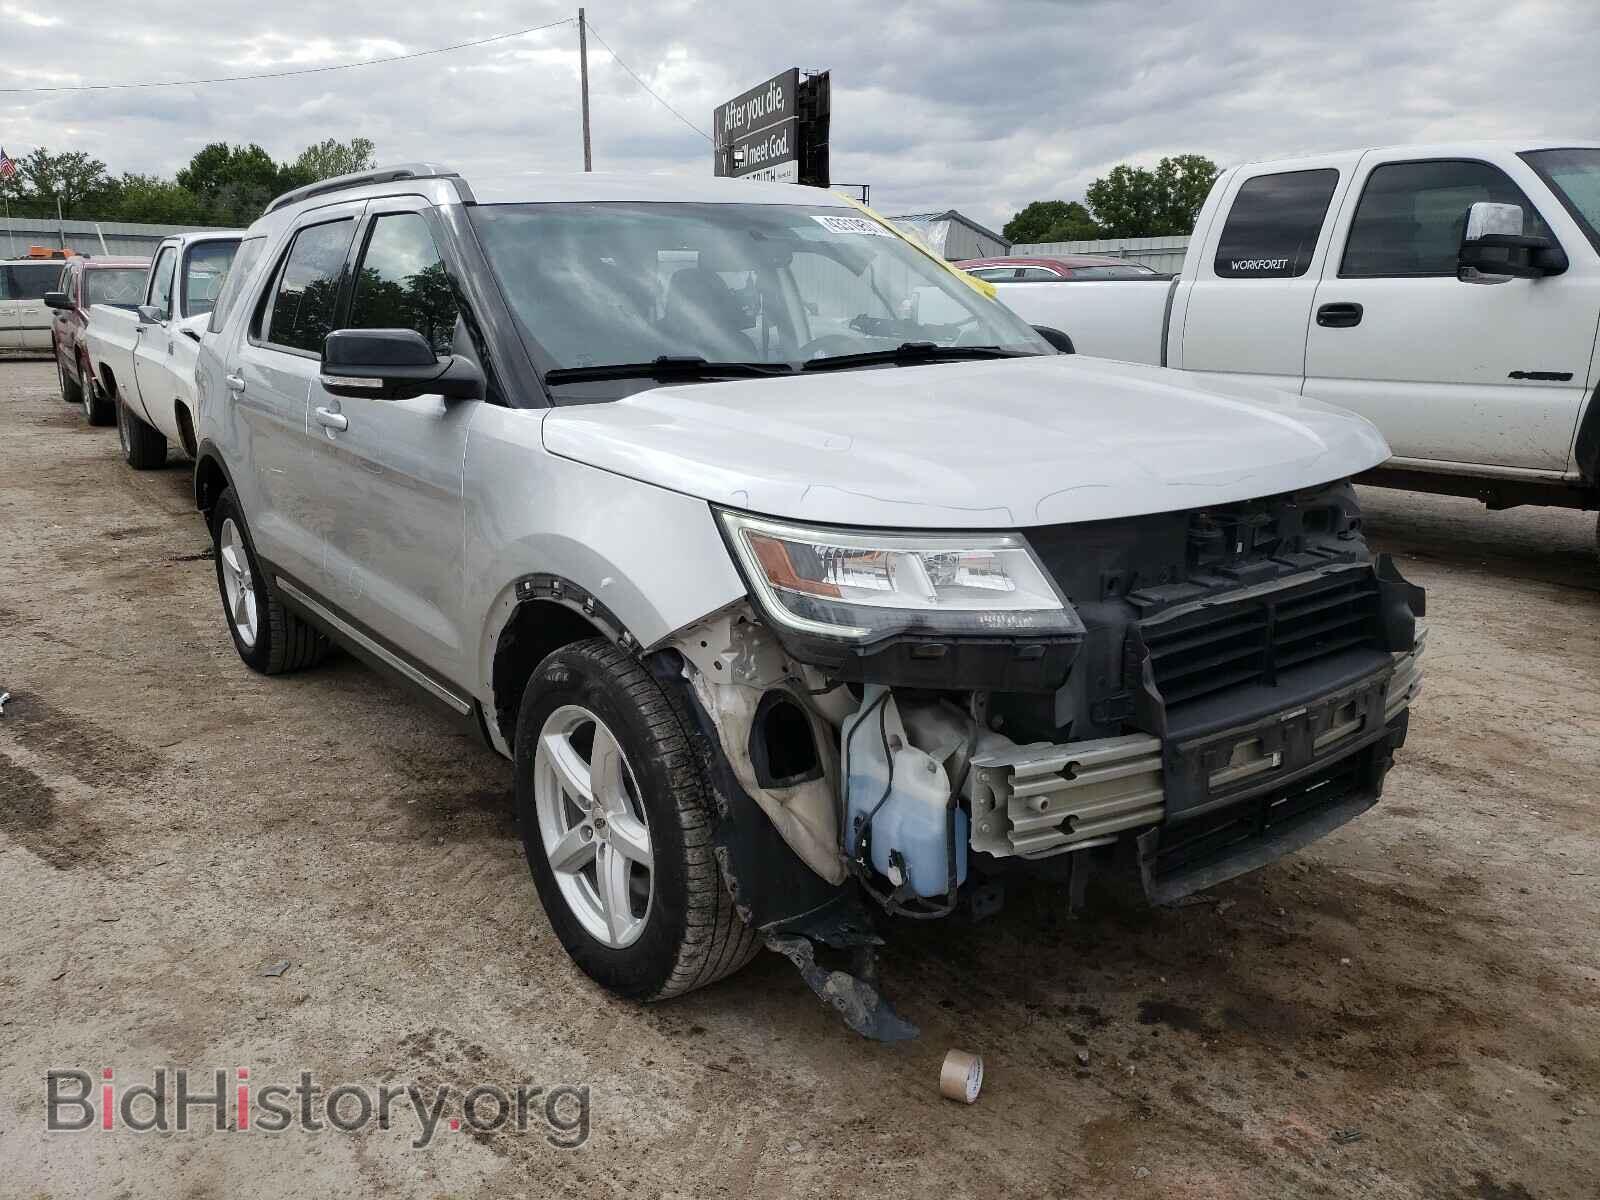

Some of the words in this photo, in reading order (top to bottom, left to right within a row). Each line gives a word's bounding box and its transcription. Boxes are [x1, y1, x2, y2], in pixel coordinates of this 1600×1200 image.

[724, 101, 745, 133] After
[746, 95, 764, 129] you
[766, 81, 785, 111] die,
[750, 139, 769, 165] meet
[769, 128, 789, 159] God.
